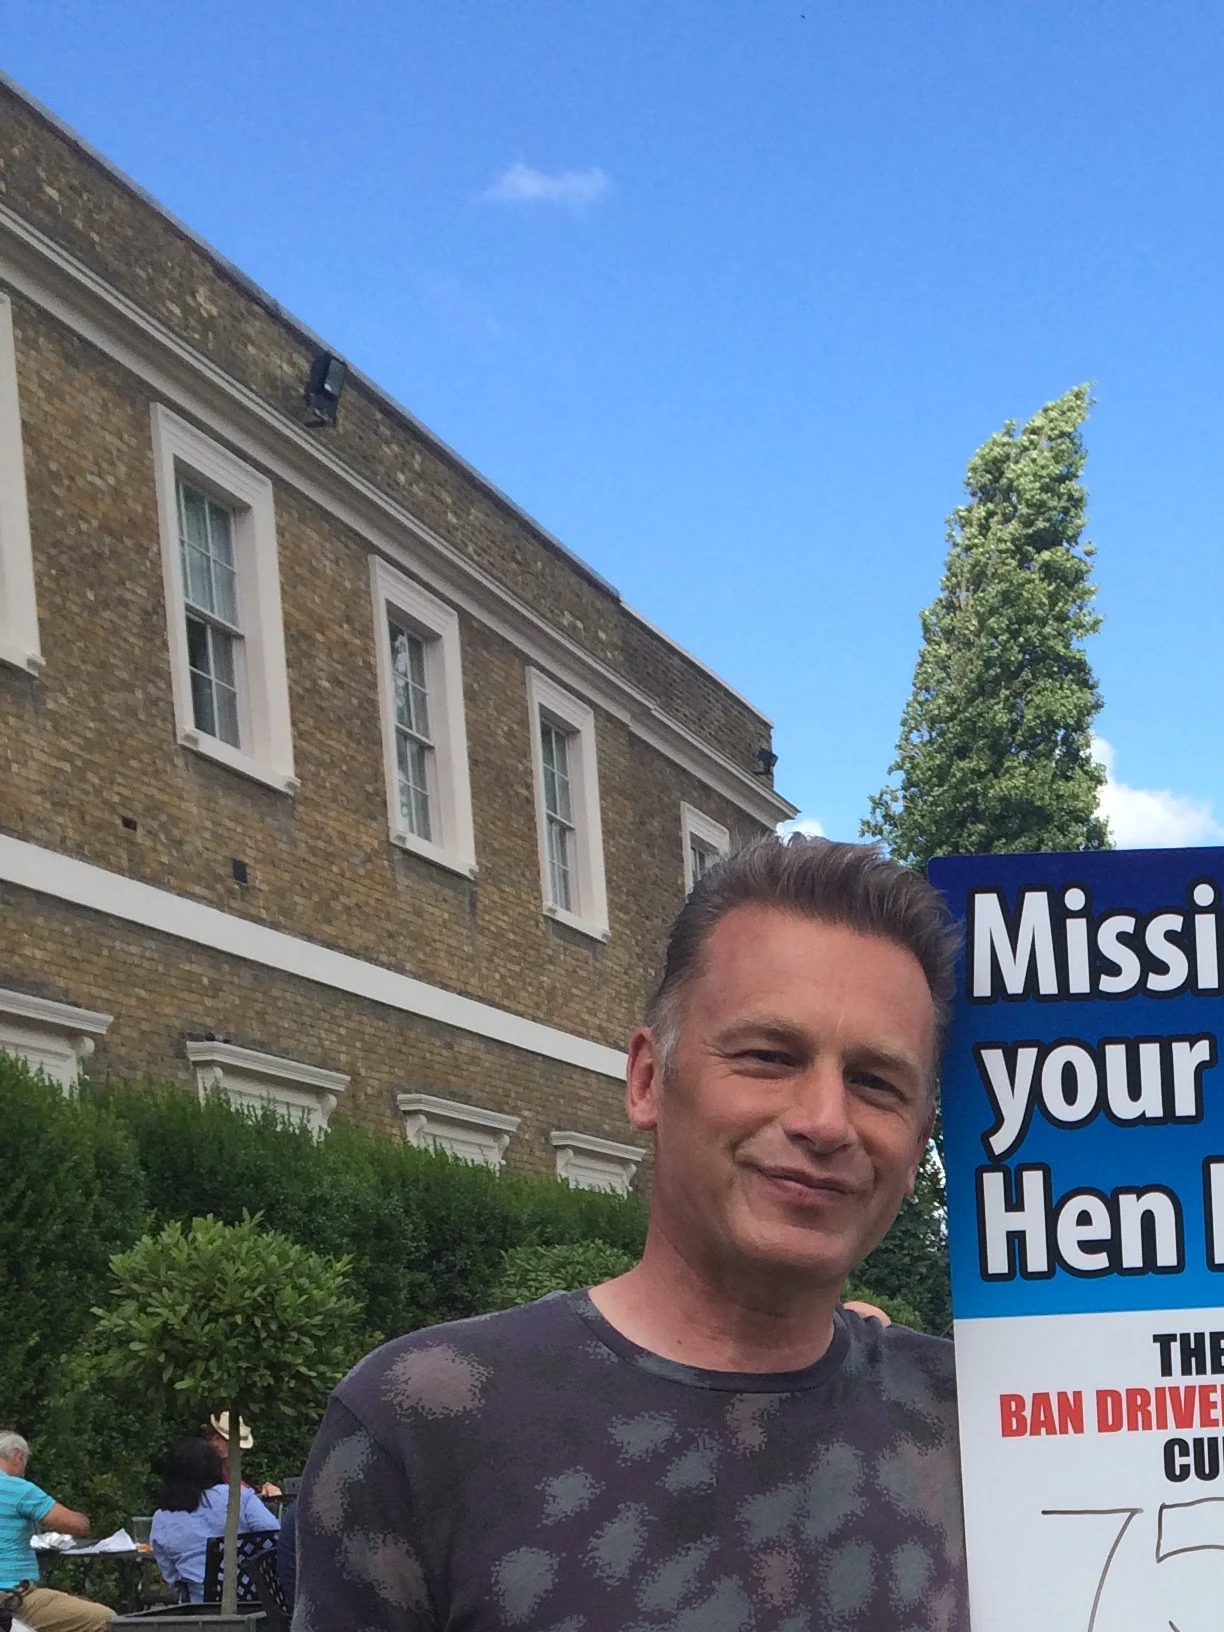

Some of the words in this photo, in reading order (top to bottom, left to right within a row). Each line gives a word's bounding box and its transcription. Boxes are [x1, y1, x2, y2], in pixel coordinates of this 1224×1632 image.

[977, 1036, 1213, 1158] your
[980, 1167, 1181, 1276] Hen
[1000, 1390, 1084, 1438] BAN
